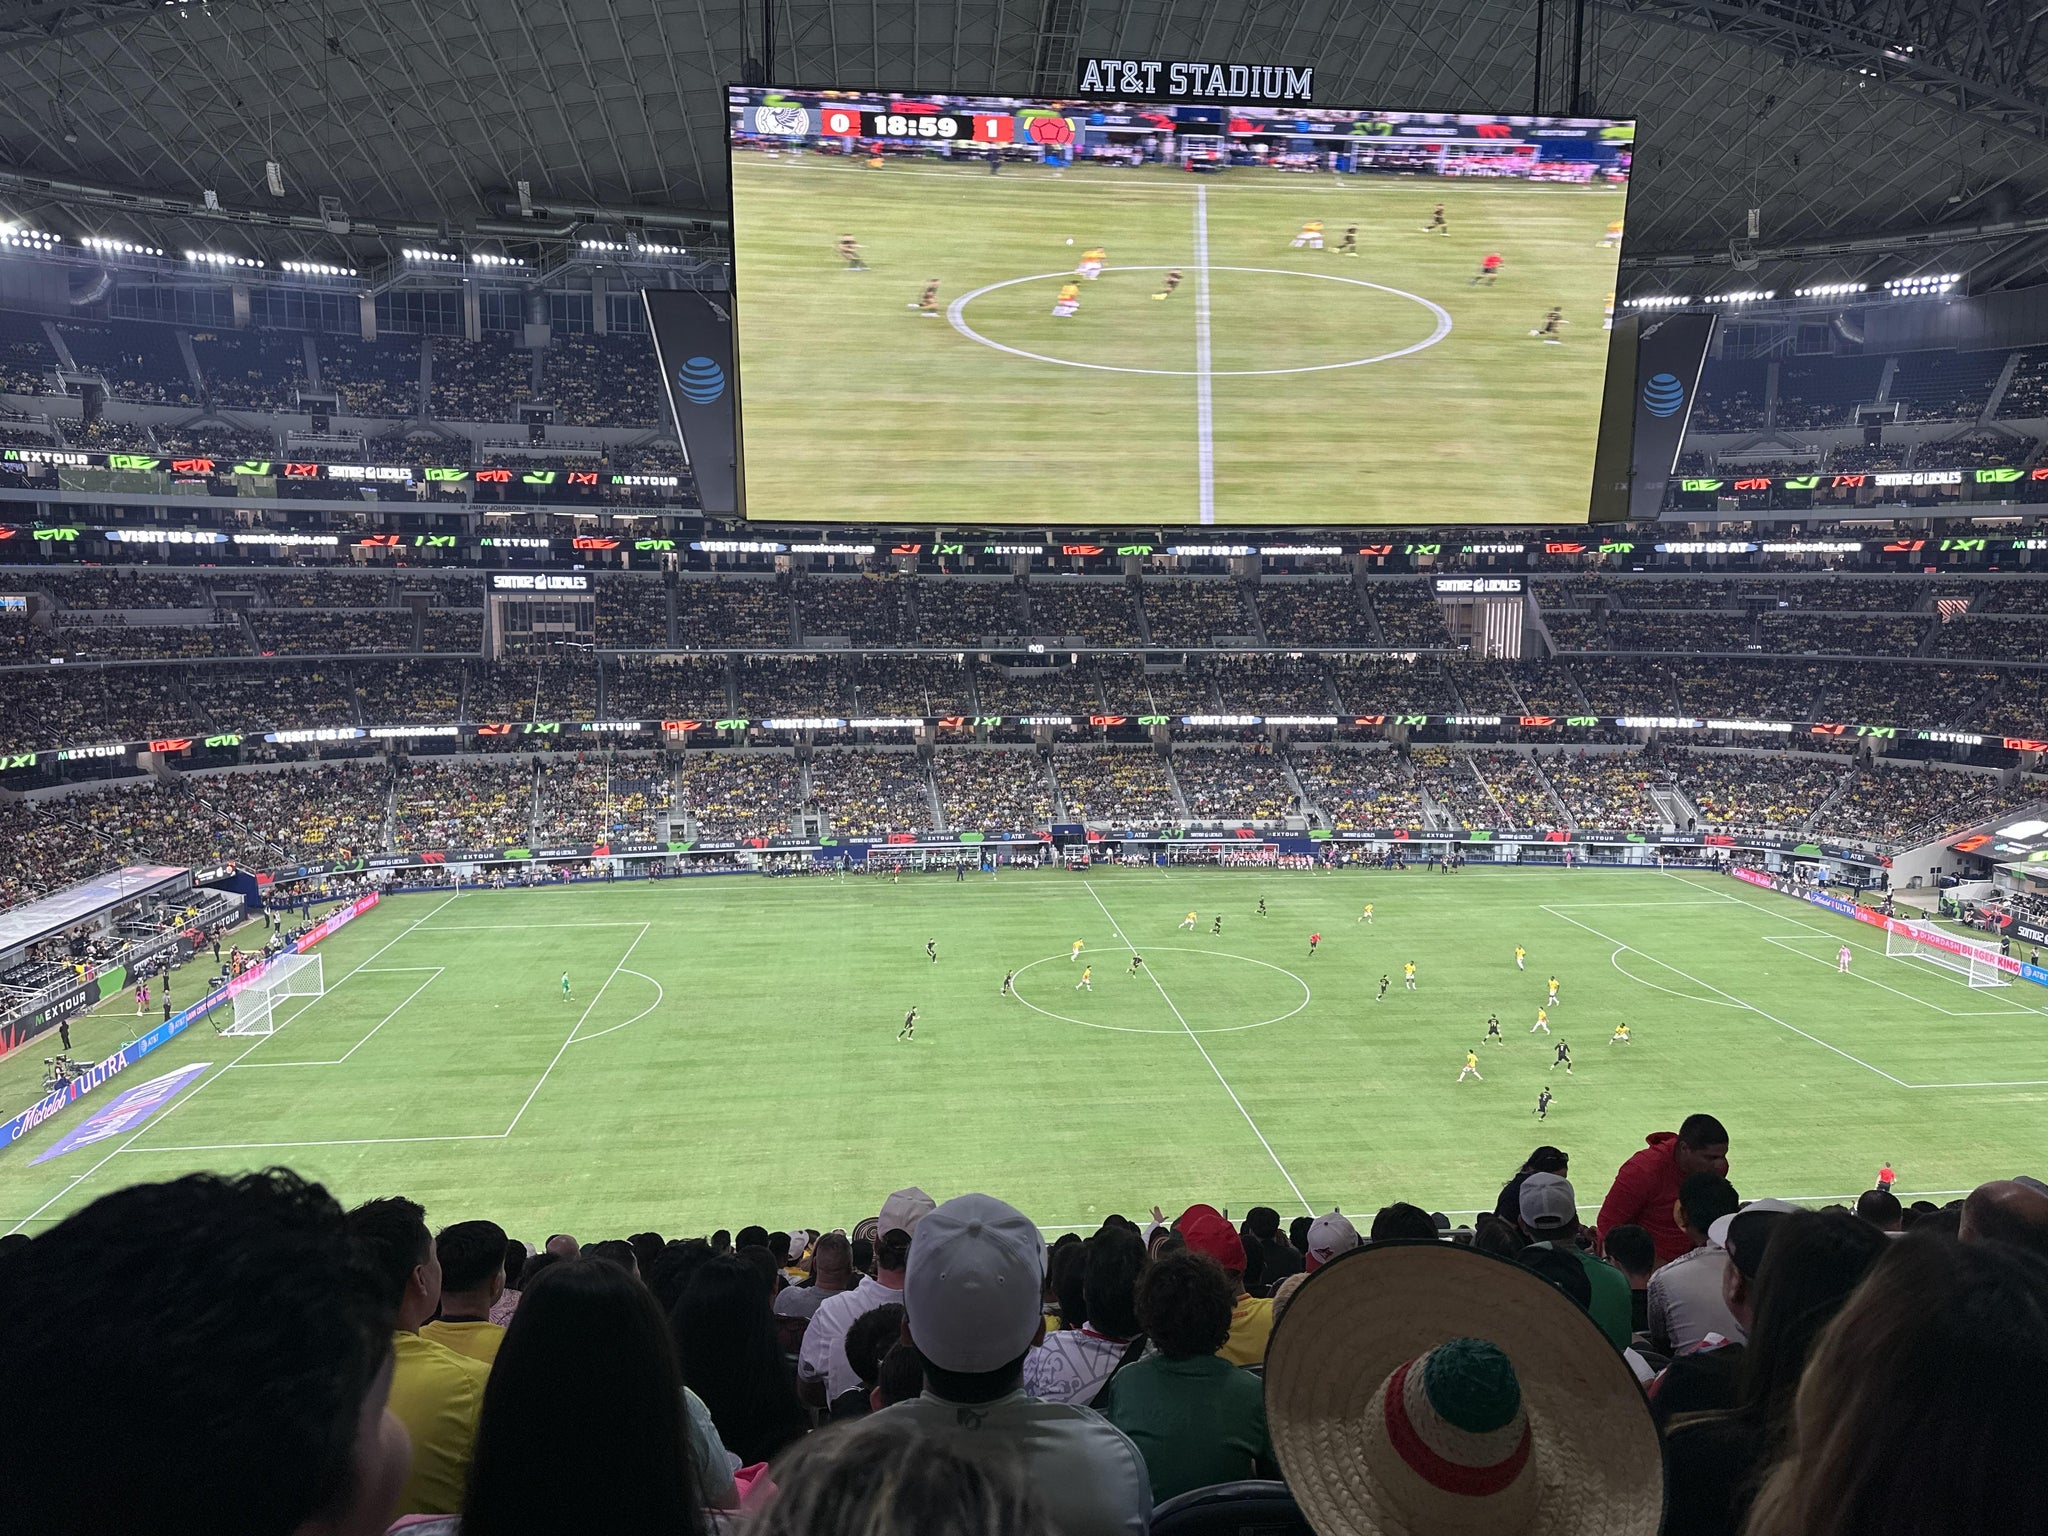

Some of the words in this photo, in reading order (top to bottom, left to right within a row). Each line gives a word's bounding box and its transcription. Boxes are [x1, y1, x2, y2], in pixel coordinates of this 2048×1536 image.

[1080, 60, 1162, 94] AT&T
[1169, 63, 1313, 99] STADIUM
[830, 113, 850, 133] 0
[874, 115, 958, 138] 18:59
[986, 119, 998, 138] 1
[118, 530, 166, 542] VISIT
[167, 531, 193, 543] US
[194, 531, 218, 543] AT
[699, 541, 738, 552] VISIT
[739, 542, 760, 552] US
[760, 542, 779, 552] AT
[1175, 545, 1211, 555] VISIT
[1212, 545, 1231, 555] US
[1231, 545, 1249, 555] AT
[1665, 543, 1704, 553] VISIT
[1706, 543, 1728, 553] US
[1728, 543, 1749, 553] AT
[771, 719, 804, 729] VISIT
[805, 719, 823, 729] US
[823, 719, 840, 729] AT
[1190, 715, 1222, 725] VISIT
[1222, 715, 1239, 725] US
[1239, 715, 1255, 725] AT
[1624, 717, 1659, 727] VISIT
[1660, 717, 1677, 728] US
[1677, 718, 1695, 728] AT
[275, 730, 315, 743] VISIT
[316, 729, 337, 742] US
[337, 728, 357, 740] AT
[307, 866, 324, 874] AT&T
[1835, 901, 1855, 916] ULTRA
[1962, 945, 1996, 964] BURGER
[1997, 957, 2019, 973] KING
[35, 992, 86, 1026] MEXTOUR
[12, 1087, 67, 1140] Michelob
[80, 1053, 130, 1094] ULTRA
